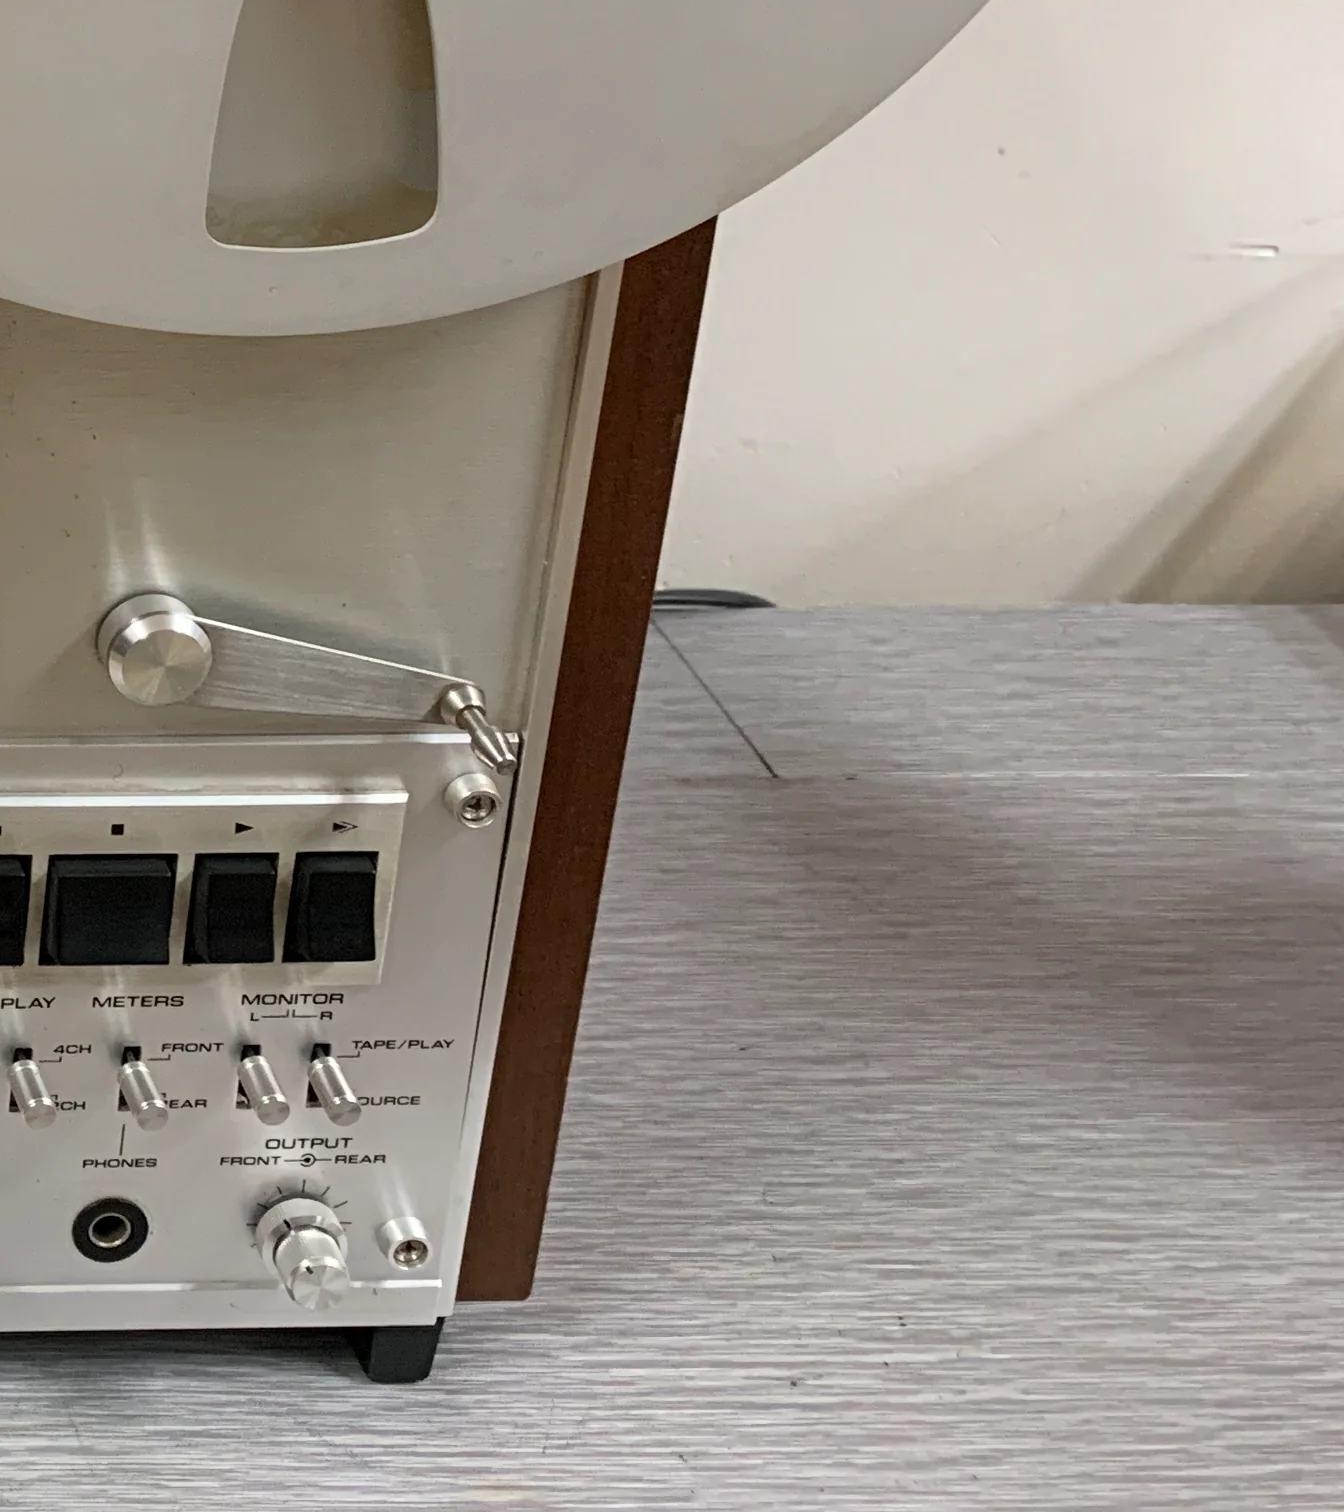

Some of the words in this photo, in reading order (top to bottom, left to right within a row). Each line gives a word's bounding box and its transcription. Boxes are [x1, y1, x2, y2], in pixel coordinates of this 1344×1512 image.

[0, 997, 56, 1009] PLAY
[92, 995, 185, 1008] METERS
[240, 993, 345, 1006] MONITOR
[250, 1012, 260, 1022] L
[320, 1010, 333, 1021] R
[53, 1044, 92, 1055] 4CH
[161, 1042, 224, 1054] FRONT
[352, 1039, 455, 1051] TAPE/PLAY
[357, 1094, 421, 1106] OURCE
[265, 1137, 353, 1151] OUTPUT
[82, 1157, 158, 1169] PHONES
[220, 1155, 282, 1167] FRONT
[334, 1154, 387, 1165] REAR
